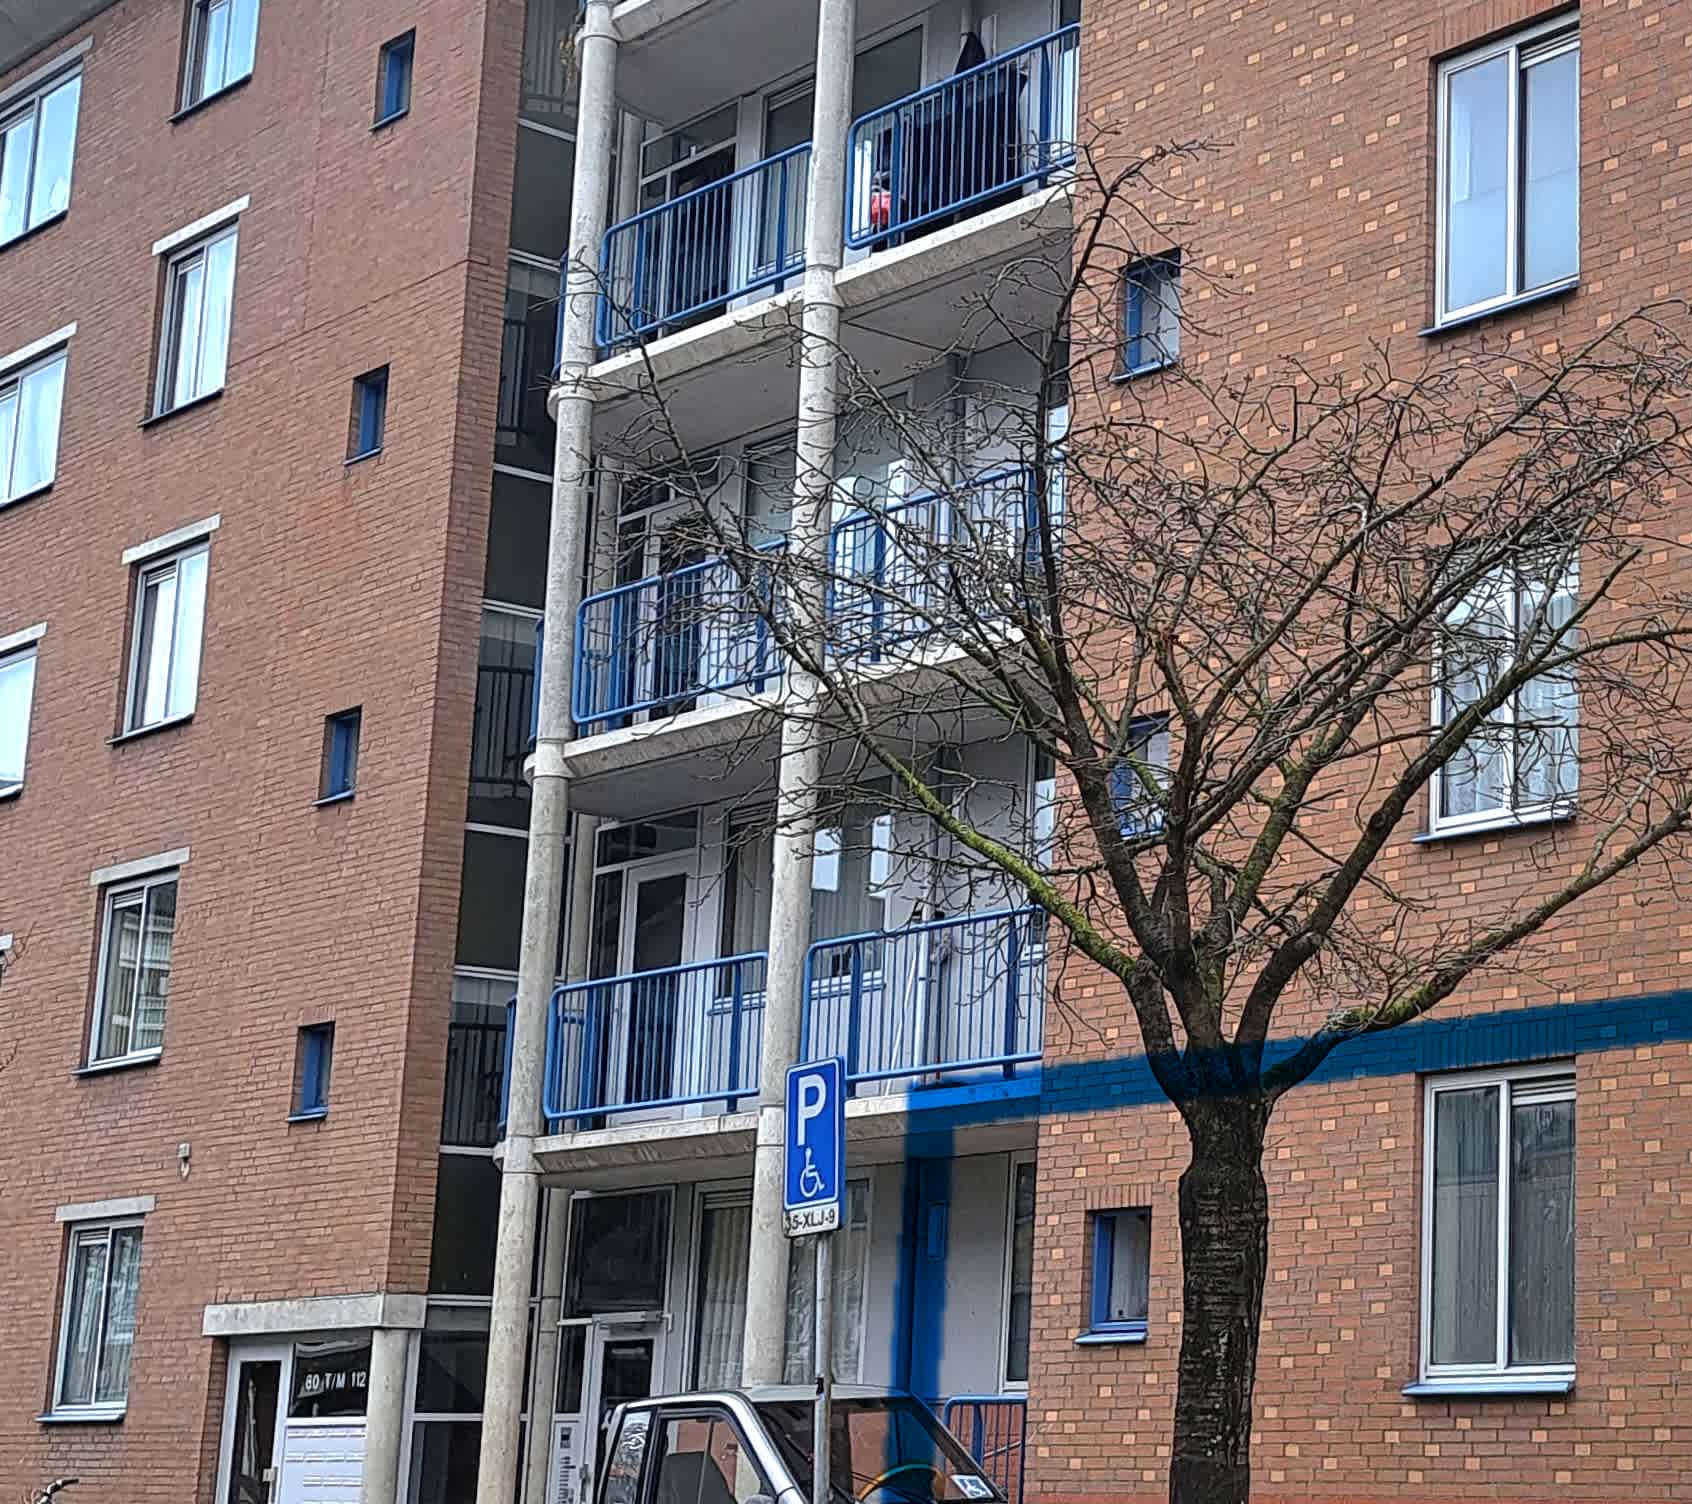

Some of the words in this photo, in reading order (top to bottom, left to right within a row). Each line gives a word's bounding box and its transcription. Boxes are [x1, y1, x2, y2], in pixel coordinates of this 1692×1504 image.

[797, 1073, 827, 1146] P
[325, 1372, 346, 1390] T/M
[351, 1371, 366, 1388] 112
